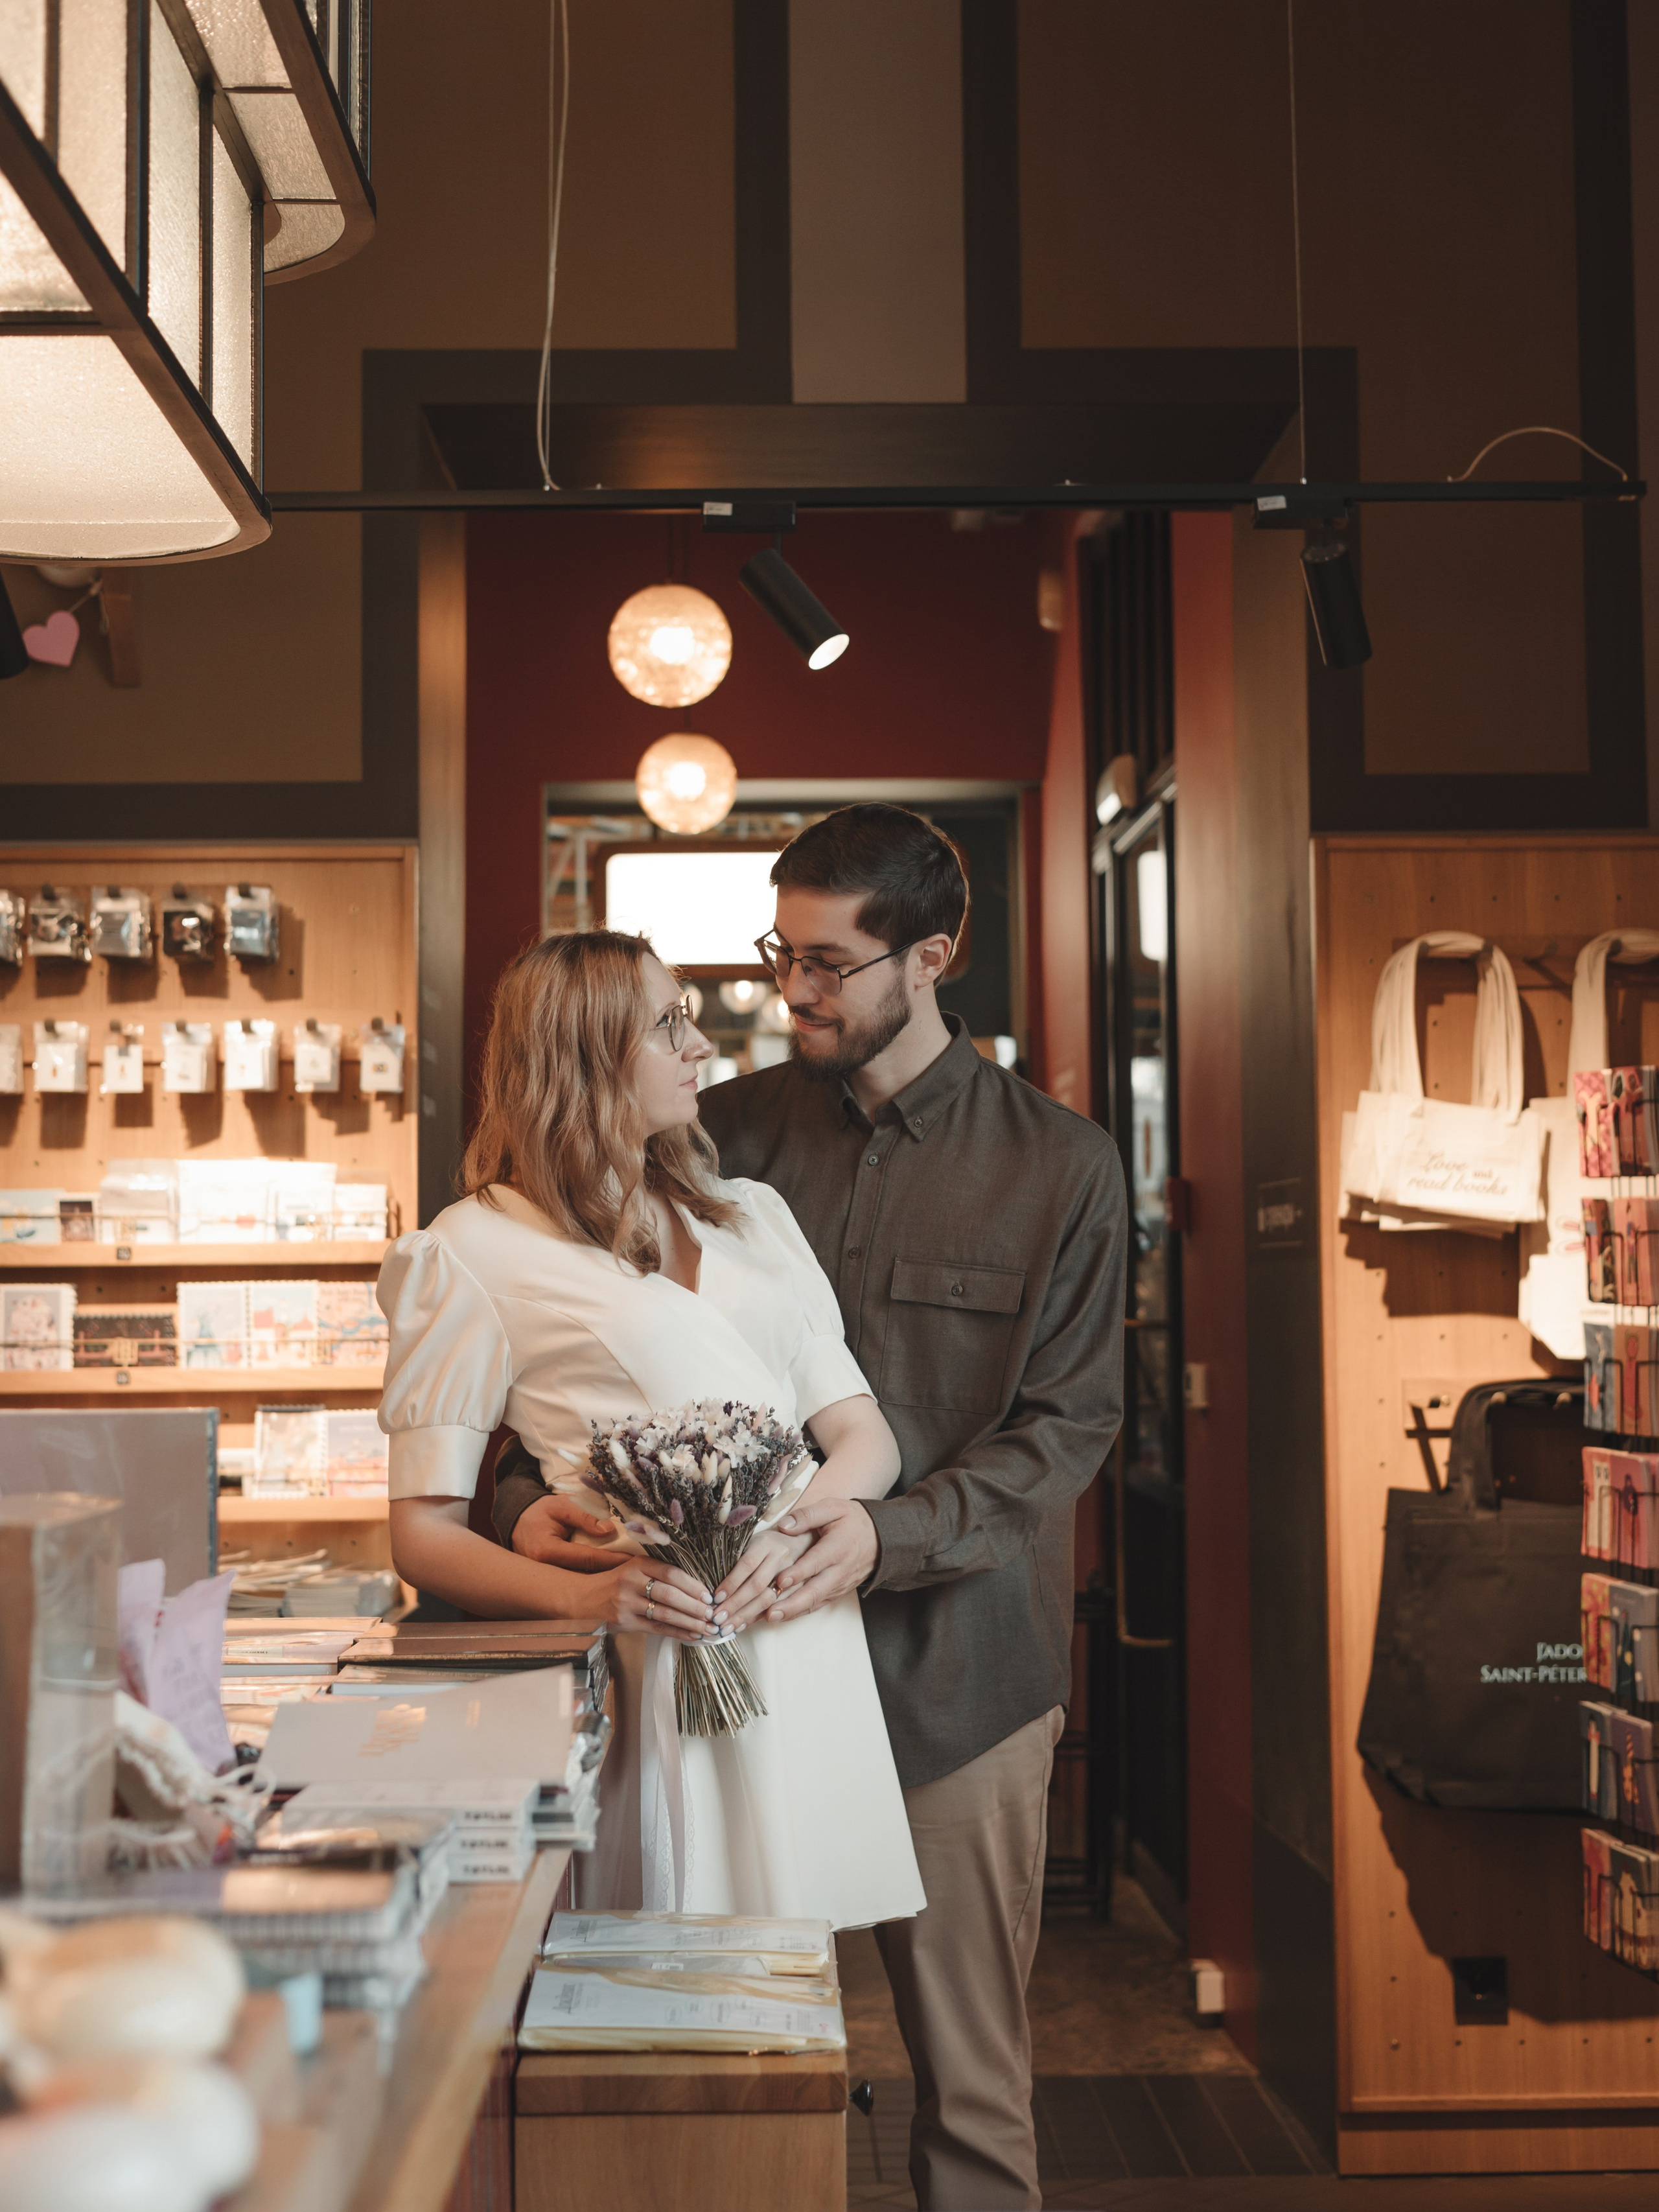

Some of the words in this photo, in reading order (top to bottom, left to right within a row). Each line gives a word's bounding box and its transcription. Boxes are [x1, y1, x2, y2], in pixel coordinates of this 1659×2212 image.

[1420, 1150, 1467, 1172] Love
[1407, 1172, 1453, 1190] read
[1452, 1174, 1508, 1195] books
